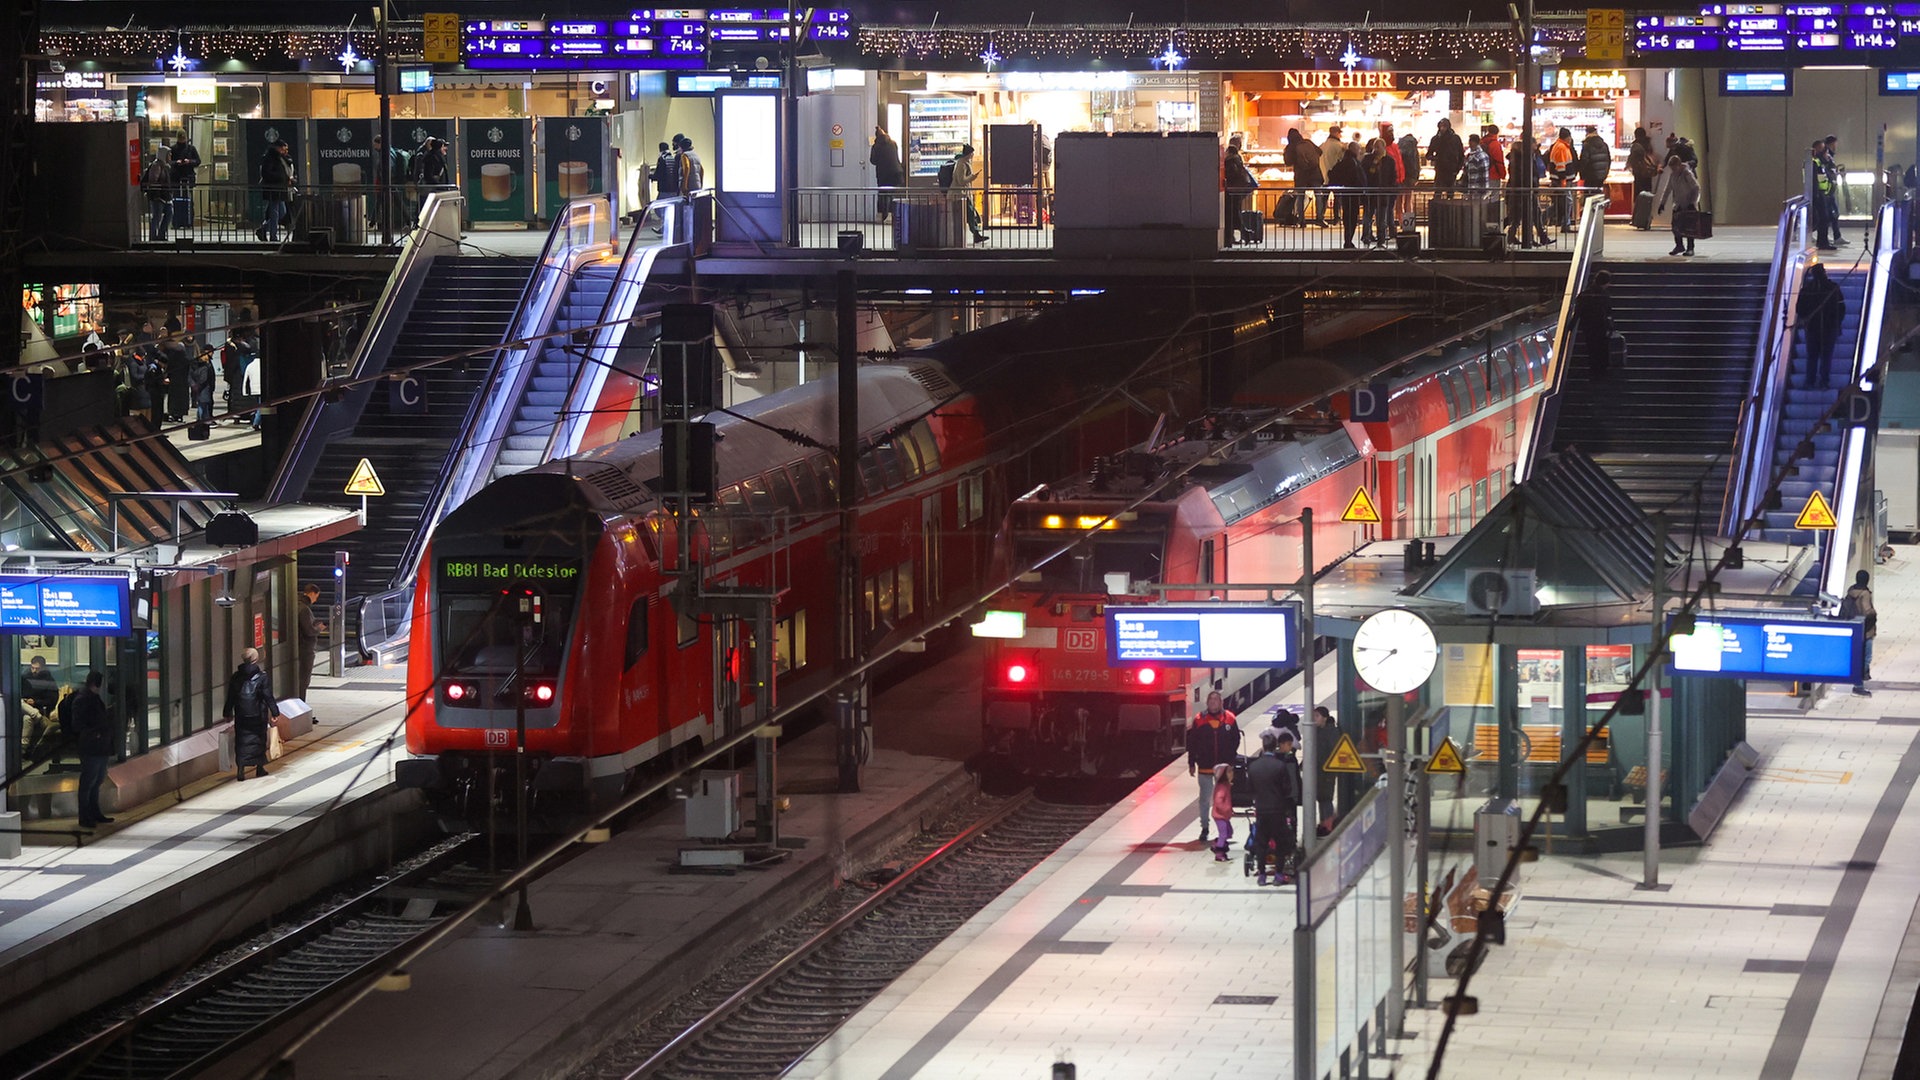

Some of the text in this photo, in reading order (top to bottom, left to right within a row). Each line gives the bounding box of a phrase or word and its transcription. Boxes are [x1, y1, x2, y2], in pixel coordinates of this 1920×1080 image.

[817, 26, 838, 37] 7-14
[478, 39, 496, 51] 1-4
[671, 40, 693, 51] 7-14
[1649, 35, 1669, 48] 1-6
[1853, 34, 1883, 47] 11-14
[1283, 72, 1393, 89] NUR HIER
[1406, 76, 1500, 86] KAFFEEWELT
[1557, 70, 1627, 89] & friends
[320, 148, 370, 158] VERSCHÖNERN
[470, 149, 521, 159] COFFEE HOUSE
[13, 376, 31, 402] C
[400, 378, 419, 405] C
[1355, 389, 1376, 417] D
[1849, 395, 1871, 422] D
[446, 563, 478, 577] RB81
[483, 563, 509, 578] Bad
[1067, 630, 1096, 650] DB
[1052, 669, 1072, 681] 146
[487, 731, 507, 745] DB
